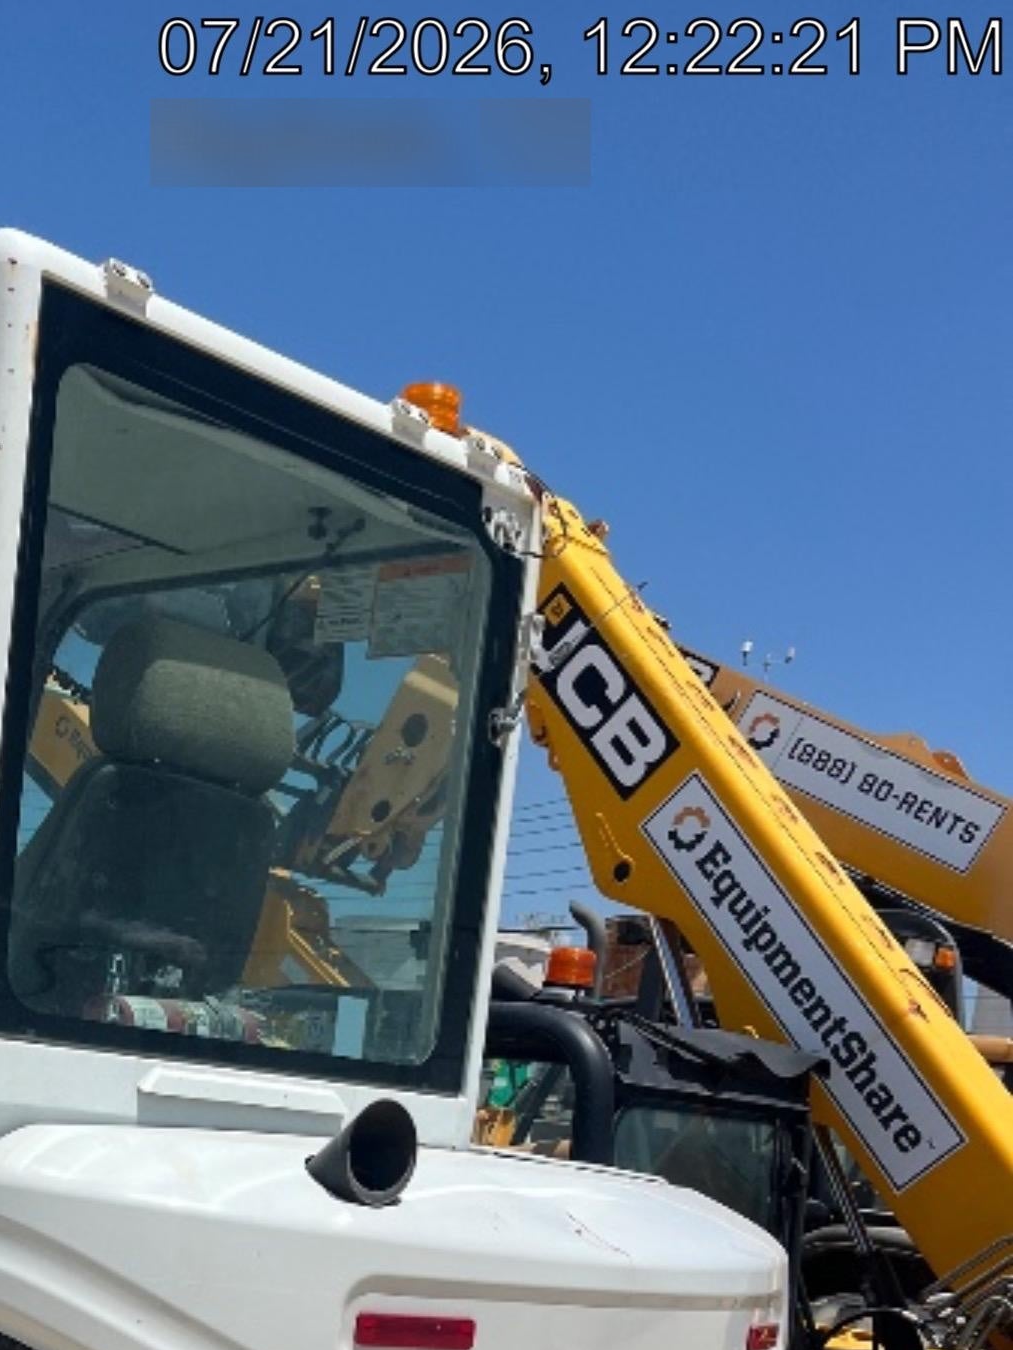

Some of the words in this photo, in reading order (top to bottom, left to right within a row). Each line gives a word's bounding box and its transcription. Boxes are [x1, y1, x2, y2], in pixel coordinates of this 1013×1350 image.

[536, 619, 668, 788] JCB
[857, 772, 982, 845] 80-RENTS
[694, 839, 923, 1154] EquipmentShare
